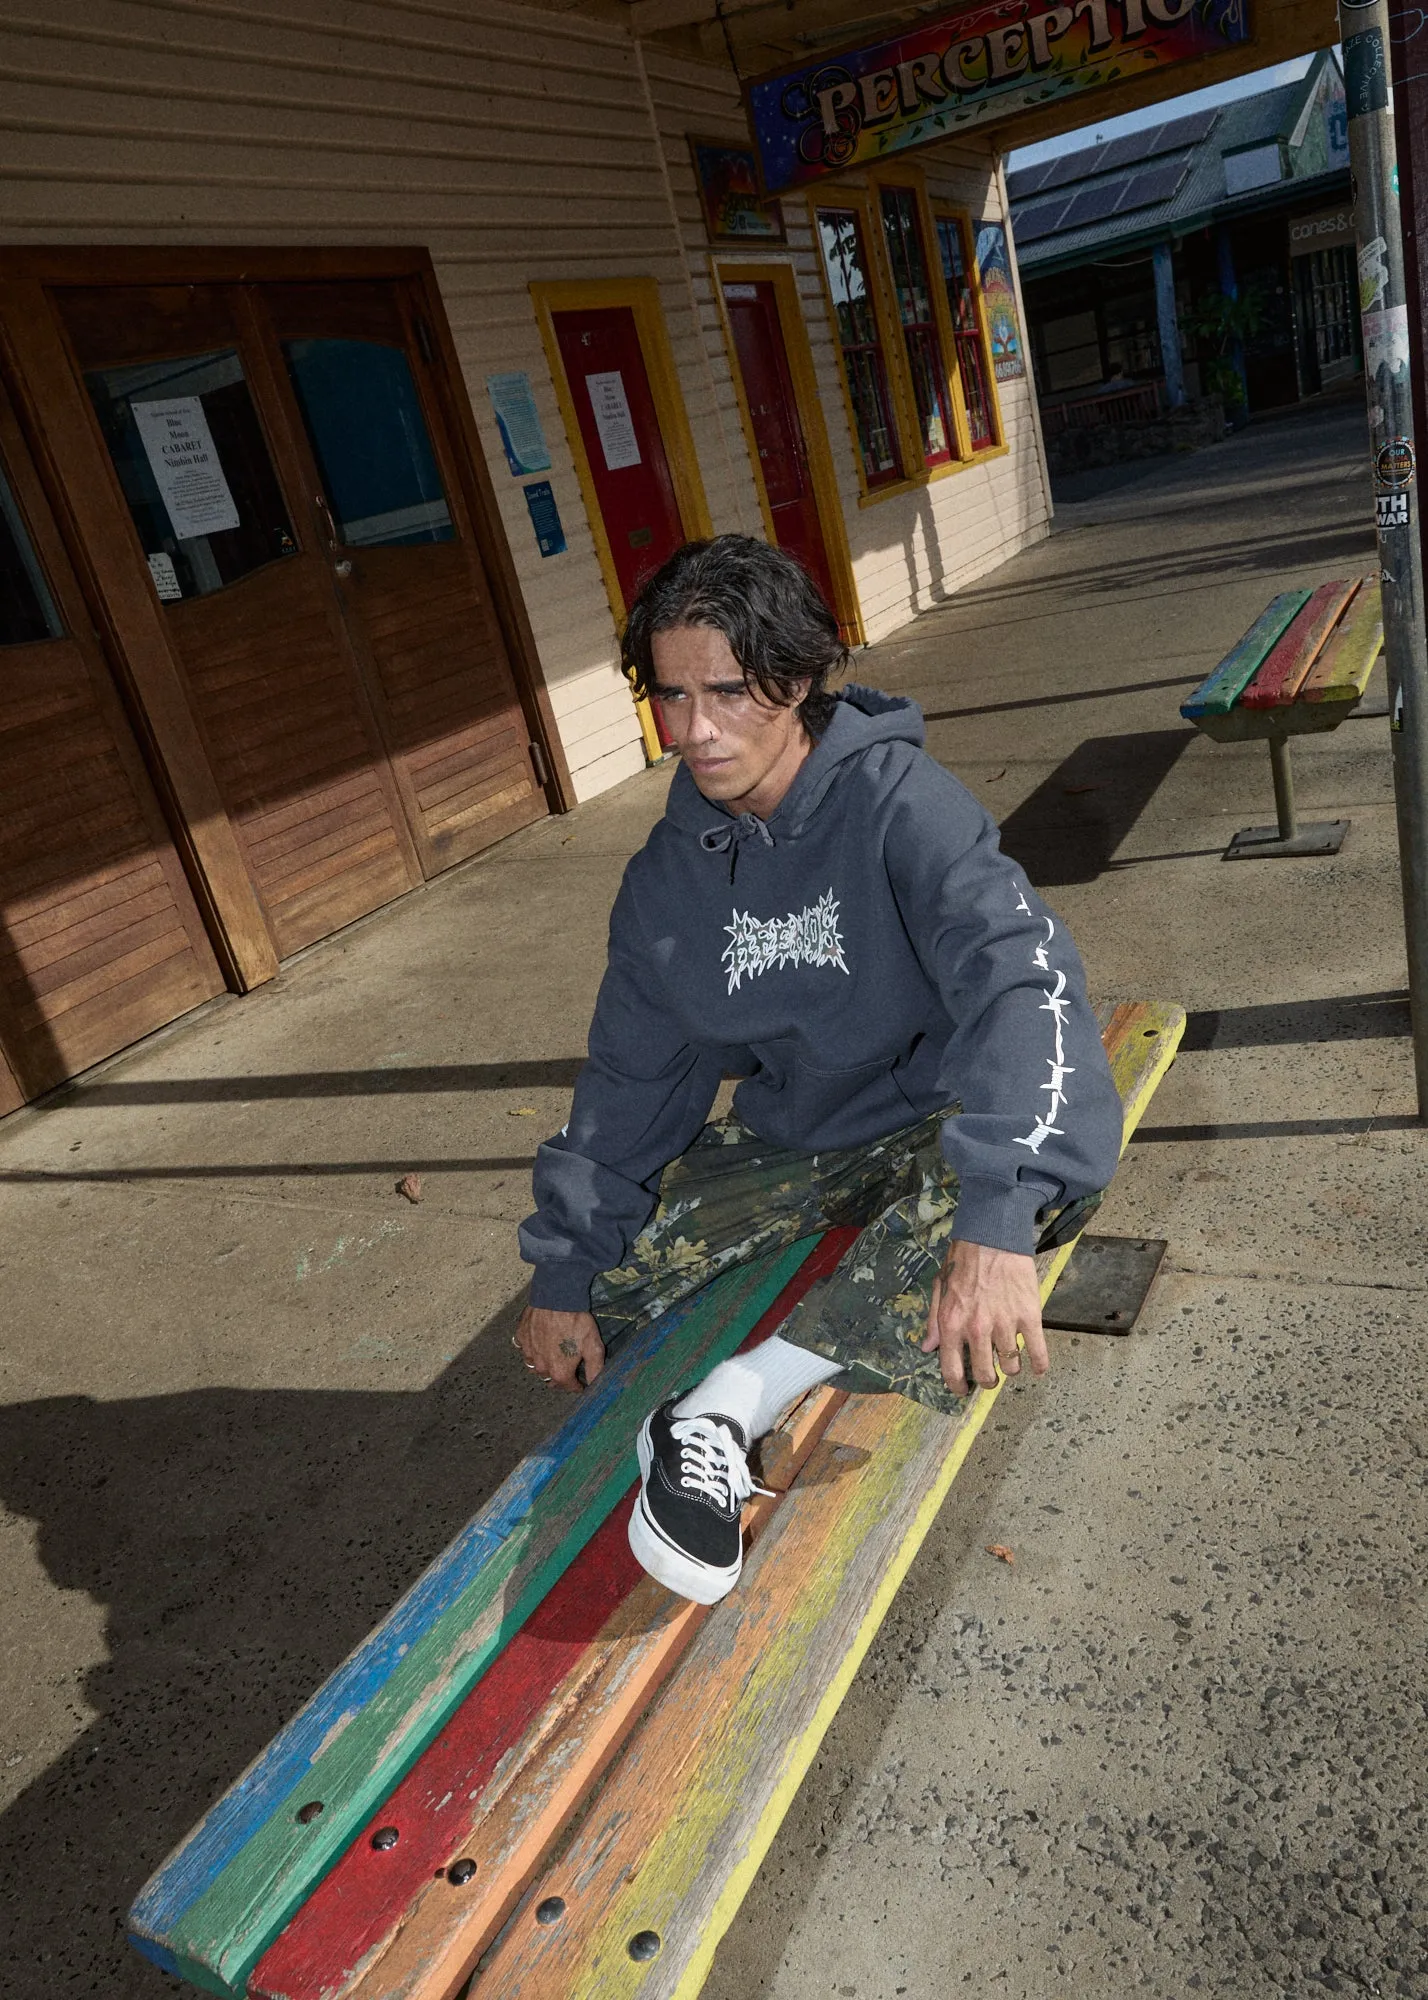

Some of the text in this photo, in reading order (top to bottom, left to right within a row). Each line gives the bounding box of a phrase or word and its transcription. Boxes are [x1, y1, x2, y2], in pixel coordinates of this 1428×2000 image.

[161, 440, 202, 454] CABARET
[1388, 448, 1405, 457] OUR
[164, 453, 209, 468] Nimbin Hall
[1381, 461, 1411, 471] MATTERS
[1376, 494, 1407, 514] TH
